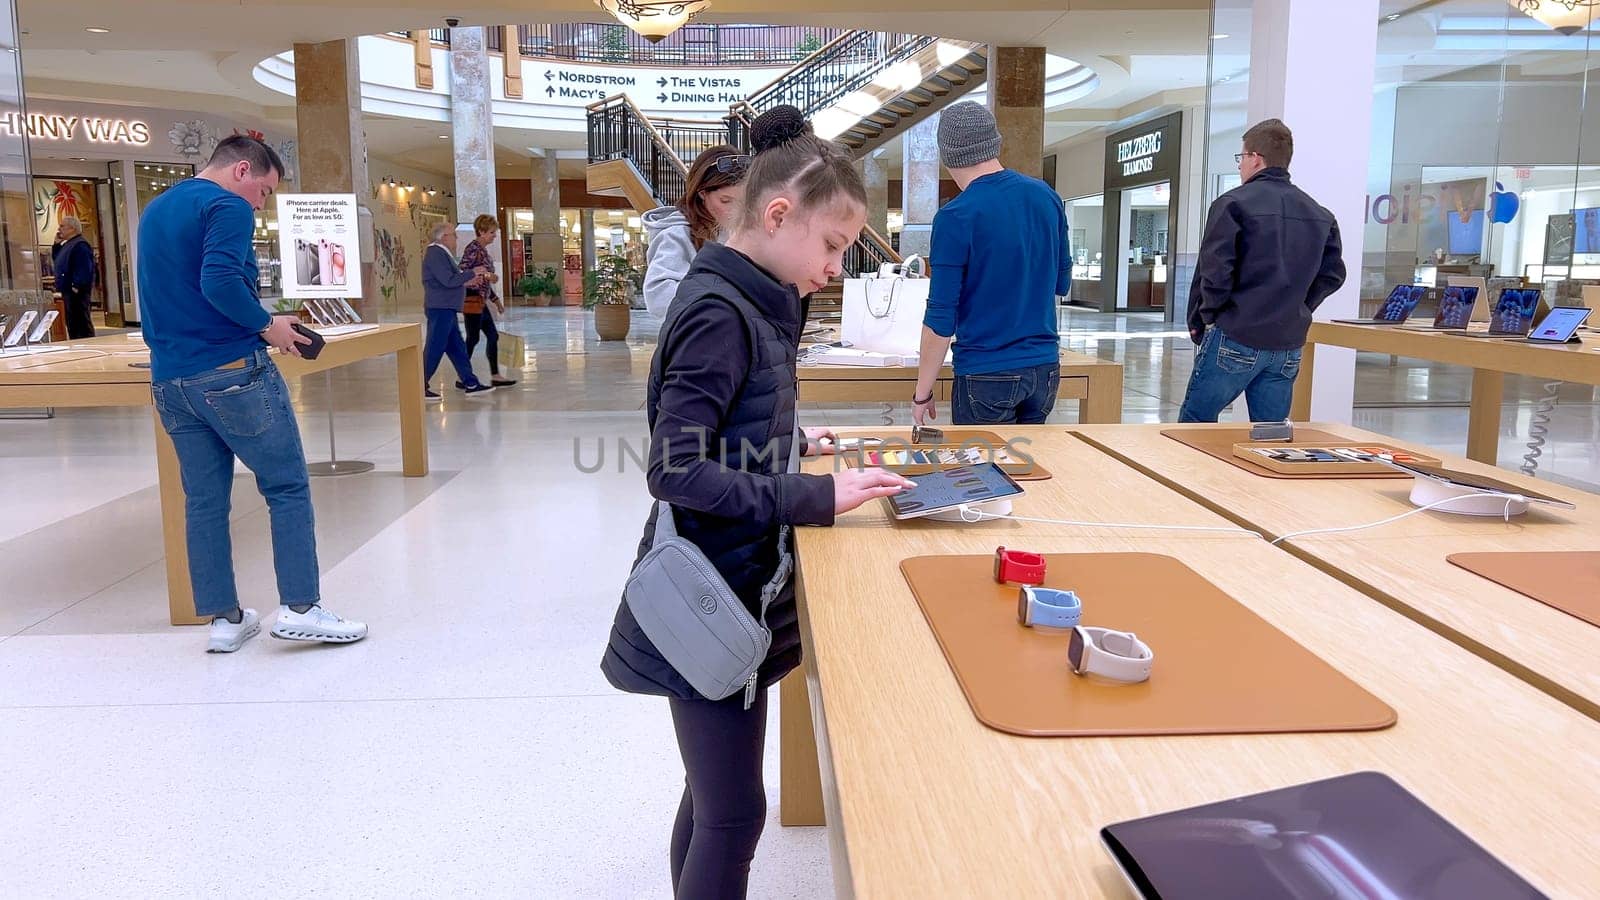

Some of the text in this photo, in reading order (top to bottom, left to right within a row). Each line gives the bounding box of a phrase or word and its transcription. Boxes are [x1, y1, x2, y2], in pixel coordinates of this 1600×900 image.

[559, 71, 636, 86] NORDSTROM
[670, 77, 741, 88] THE VISTAS
[671, 92, 715, 102] DINING
[84, 119, 149, 143] WAS
[1117, 131, 1161, 162] HELZBERG
[1123, 157, 1153, 176] DIAMONDS
